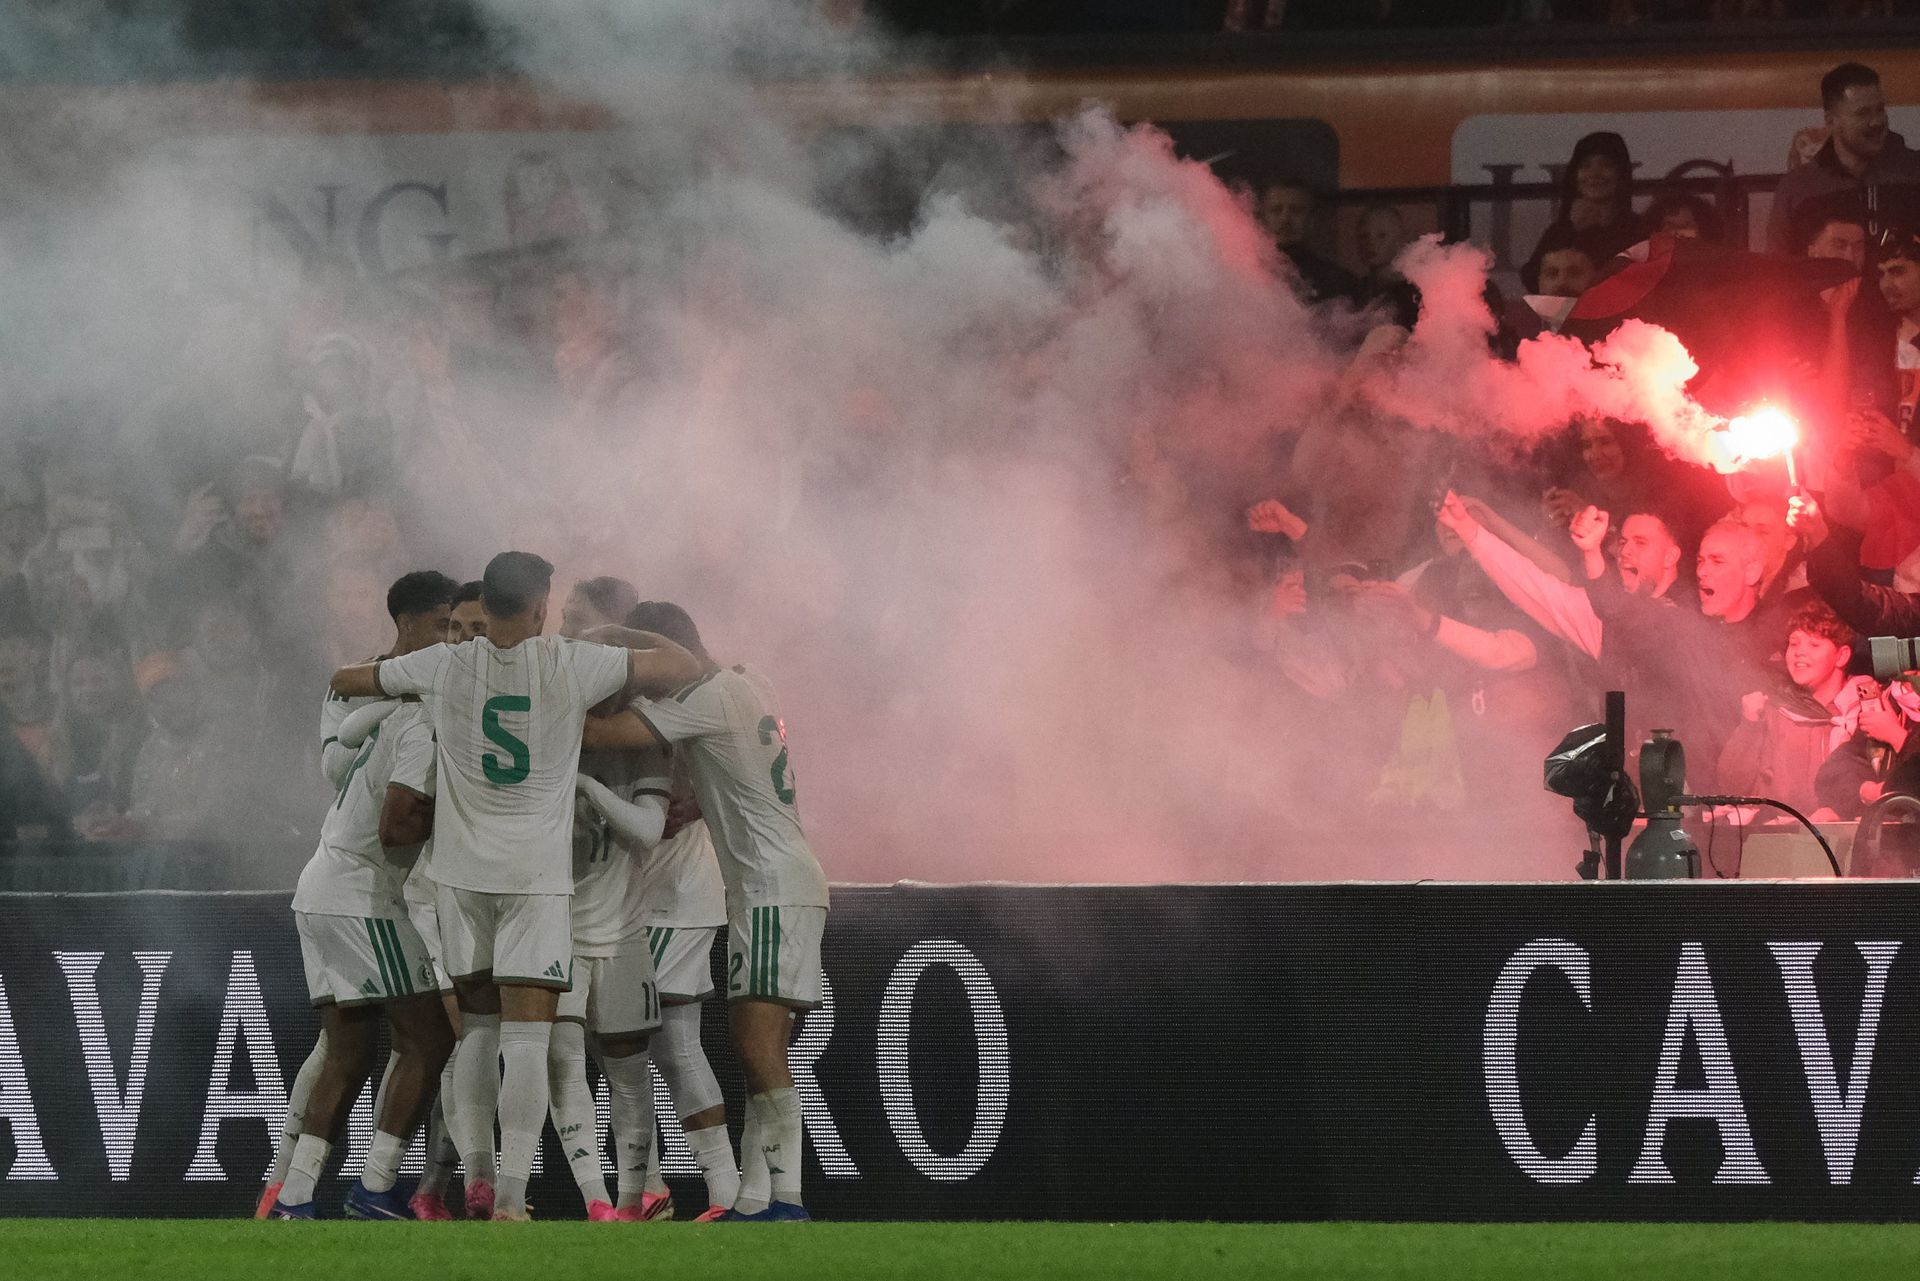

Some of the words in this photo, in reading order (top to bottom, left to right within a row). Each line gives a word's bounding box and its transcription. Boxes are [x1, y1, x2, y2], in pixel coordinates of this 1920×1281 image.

[481, 695, 531, 785] 5
[641, 980, 659, 1021] 11
[1482, 938, 1920, 1186] CAV
[560, 1122, 583, 1137] FAF
